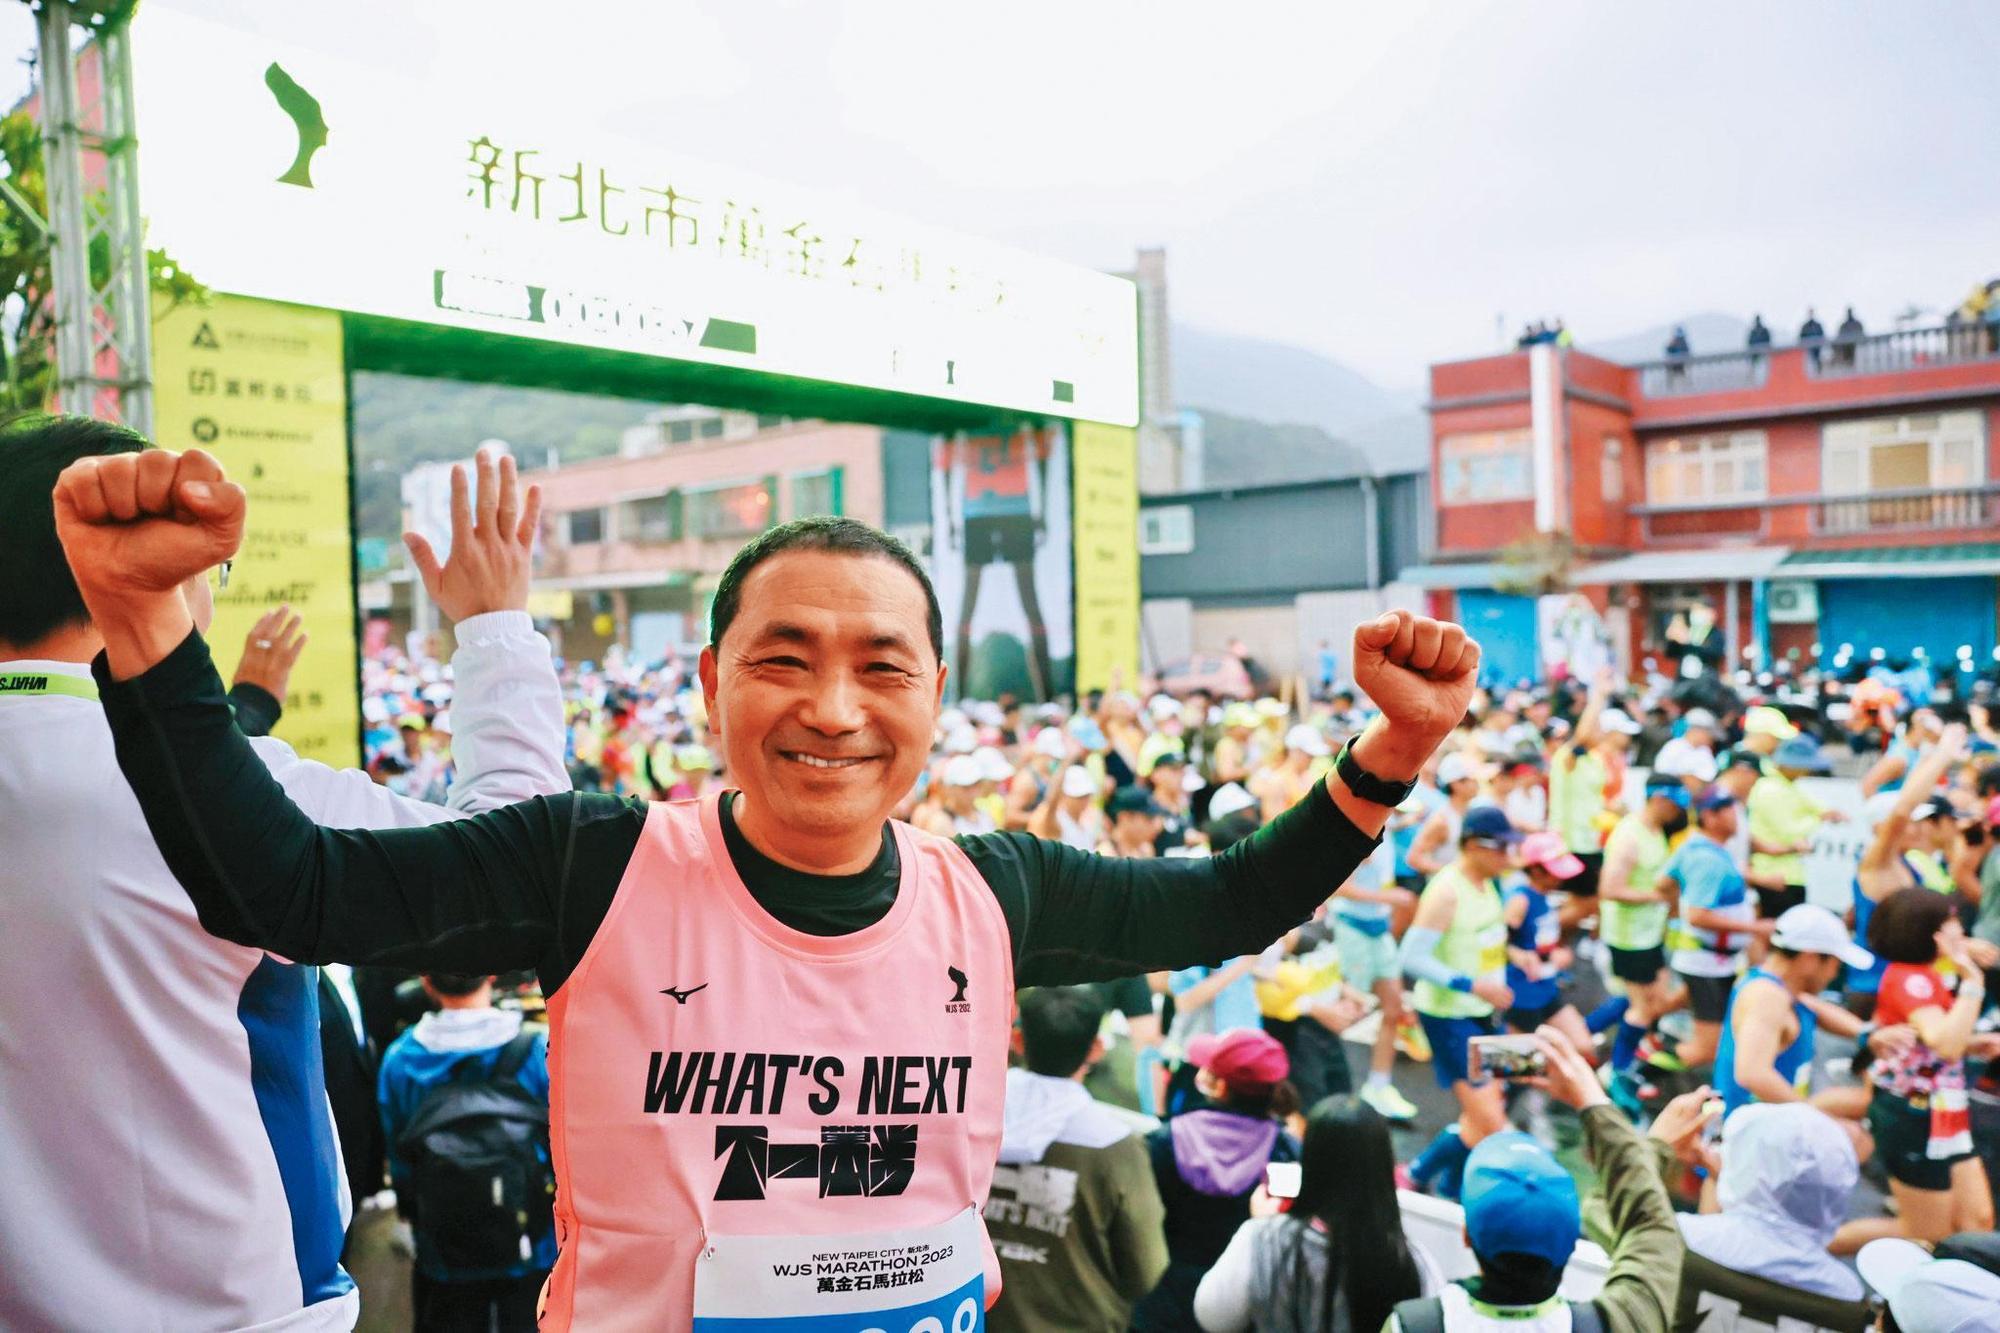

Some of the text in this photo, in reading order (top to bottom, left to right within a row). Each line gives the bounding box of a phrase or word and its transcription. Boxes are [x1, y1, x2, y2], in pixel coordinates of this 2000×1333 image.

[945, 1004, 958, 1013] WJS
[643, 1051, 972, 1116] WHAT'S NEXT
[773, 1245, 954, 1276] WJS MARATHON 2023
[812, 1244, 930, 1262] NEW TAIPEI CITY 新北市
[817, 1268, 925, 1294] 萬金石馬拉松
